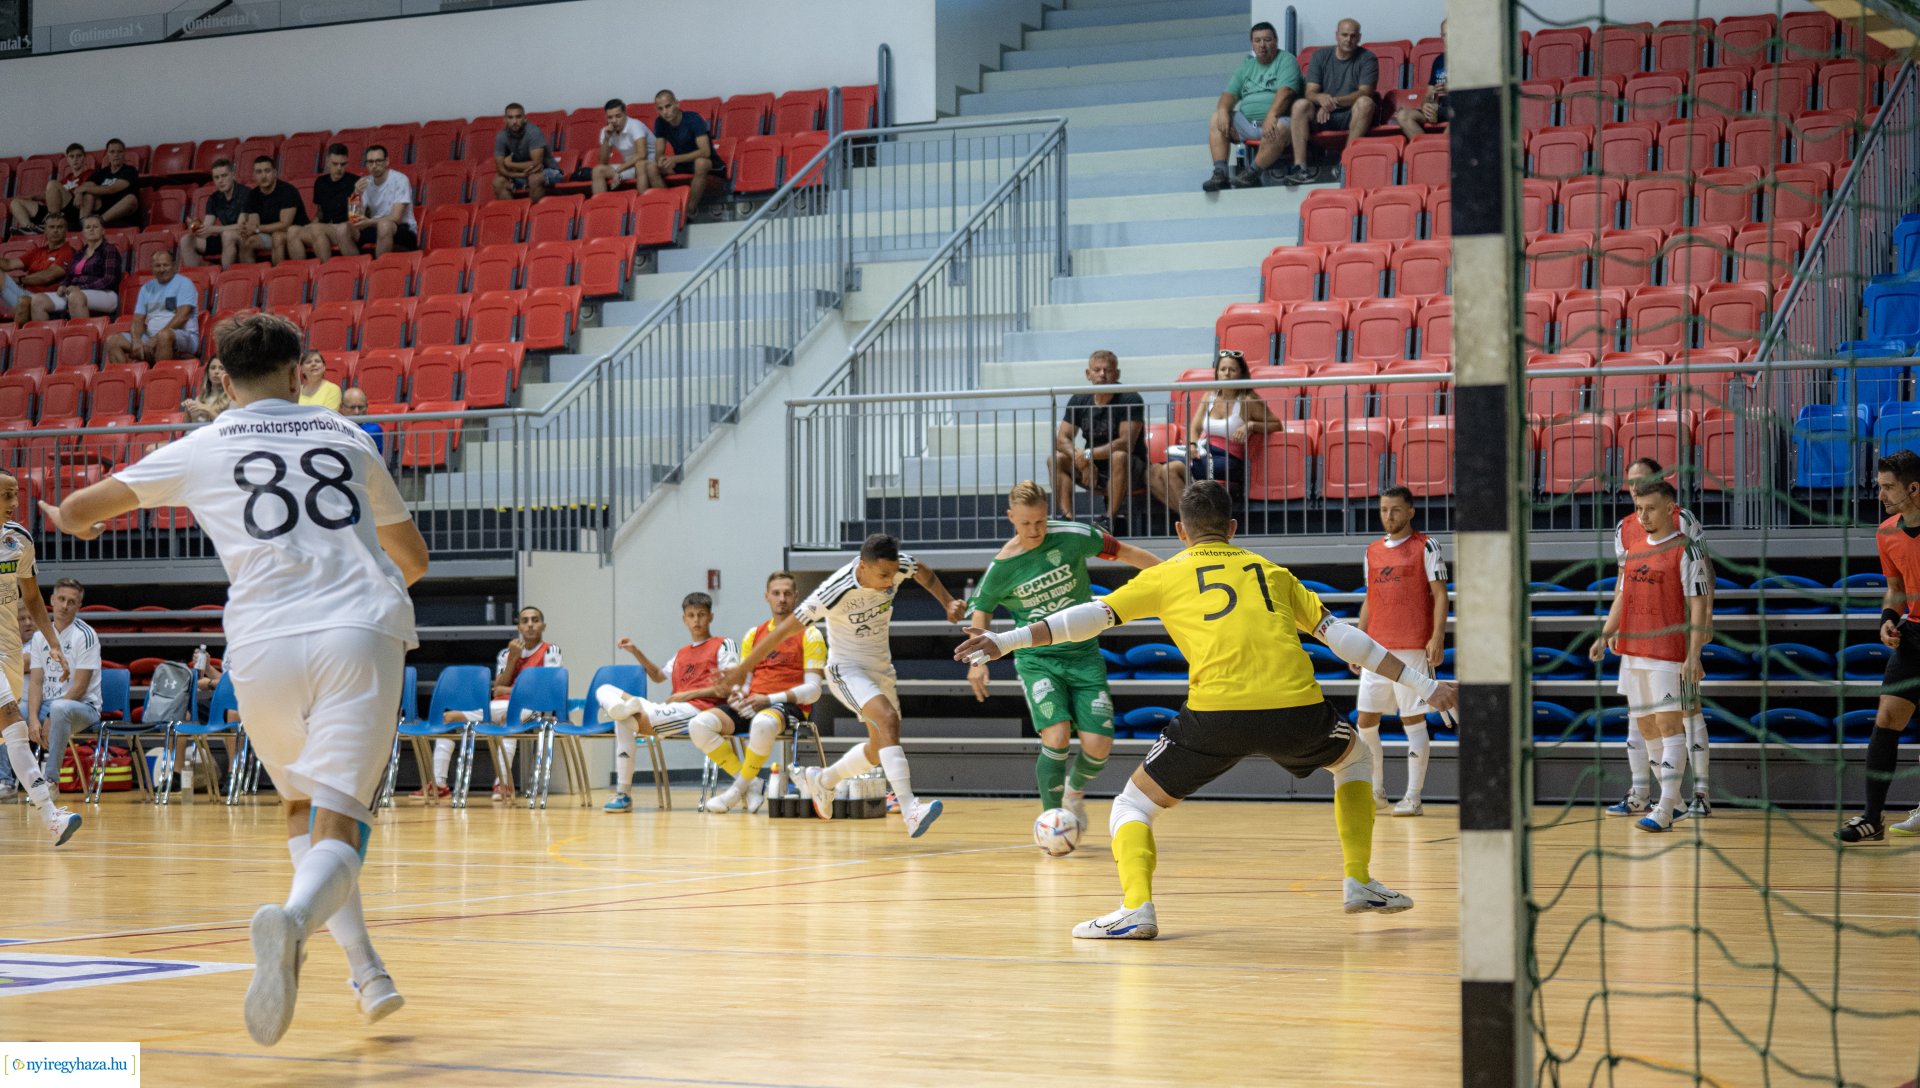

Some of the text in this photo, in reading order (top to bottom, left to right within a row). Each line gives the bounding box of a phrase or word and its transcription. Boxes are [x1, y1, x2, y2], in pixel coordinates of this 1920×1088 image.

[69, 23, 134, 47] Continental
[218, 417, 355, 438] www.raktarsportbolt.hu
[234, 447, 361, 540] 88
[1196, 563, 1275, 622] 51
